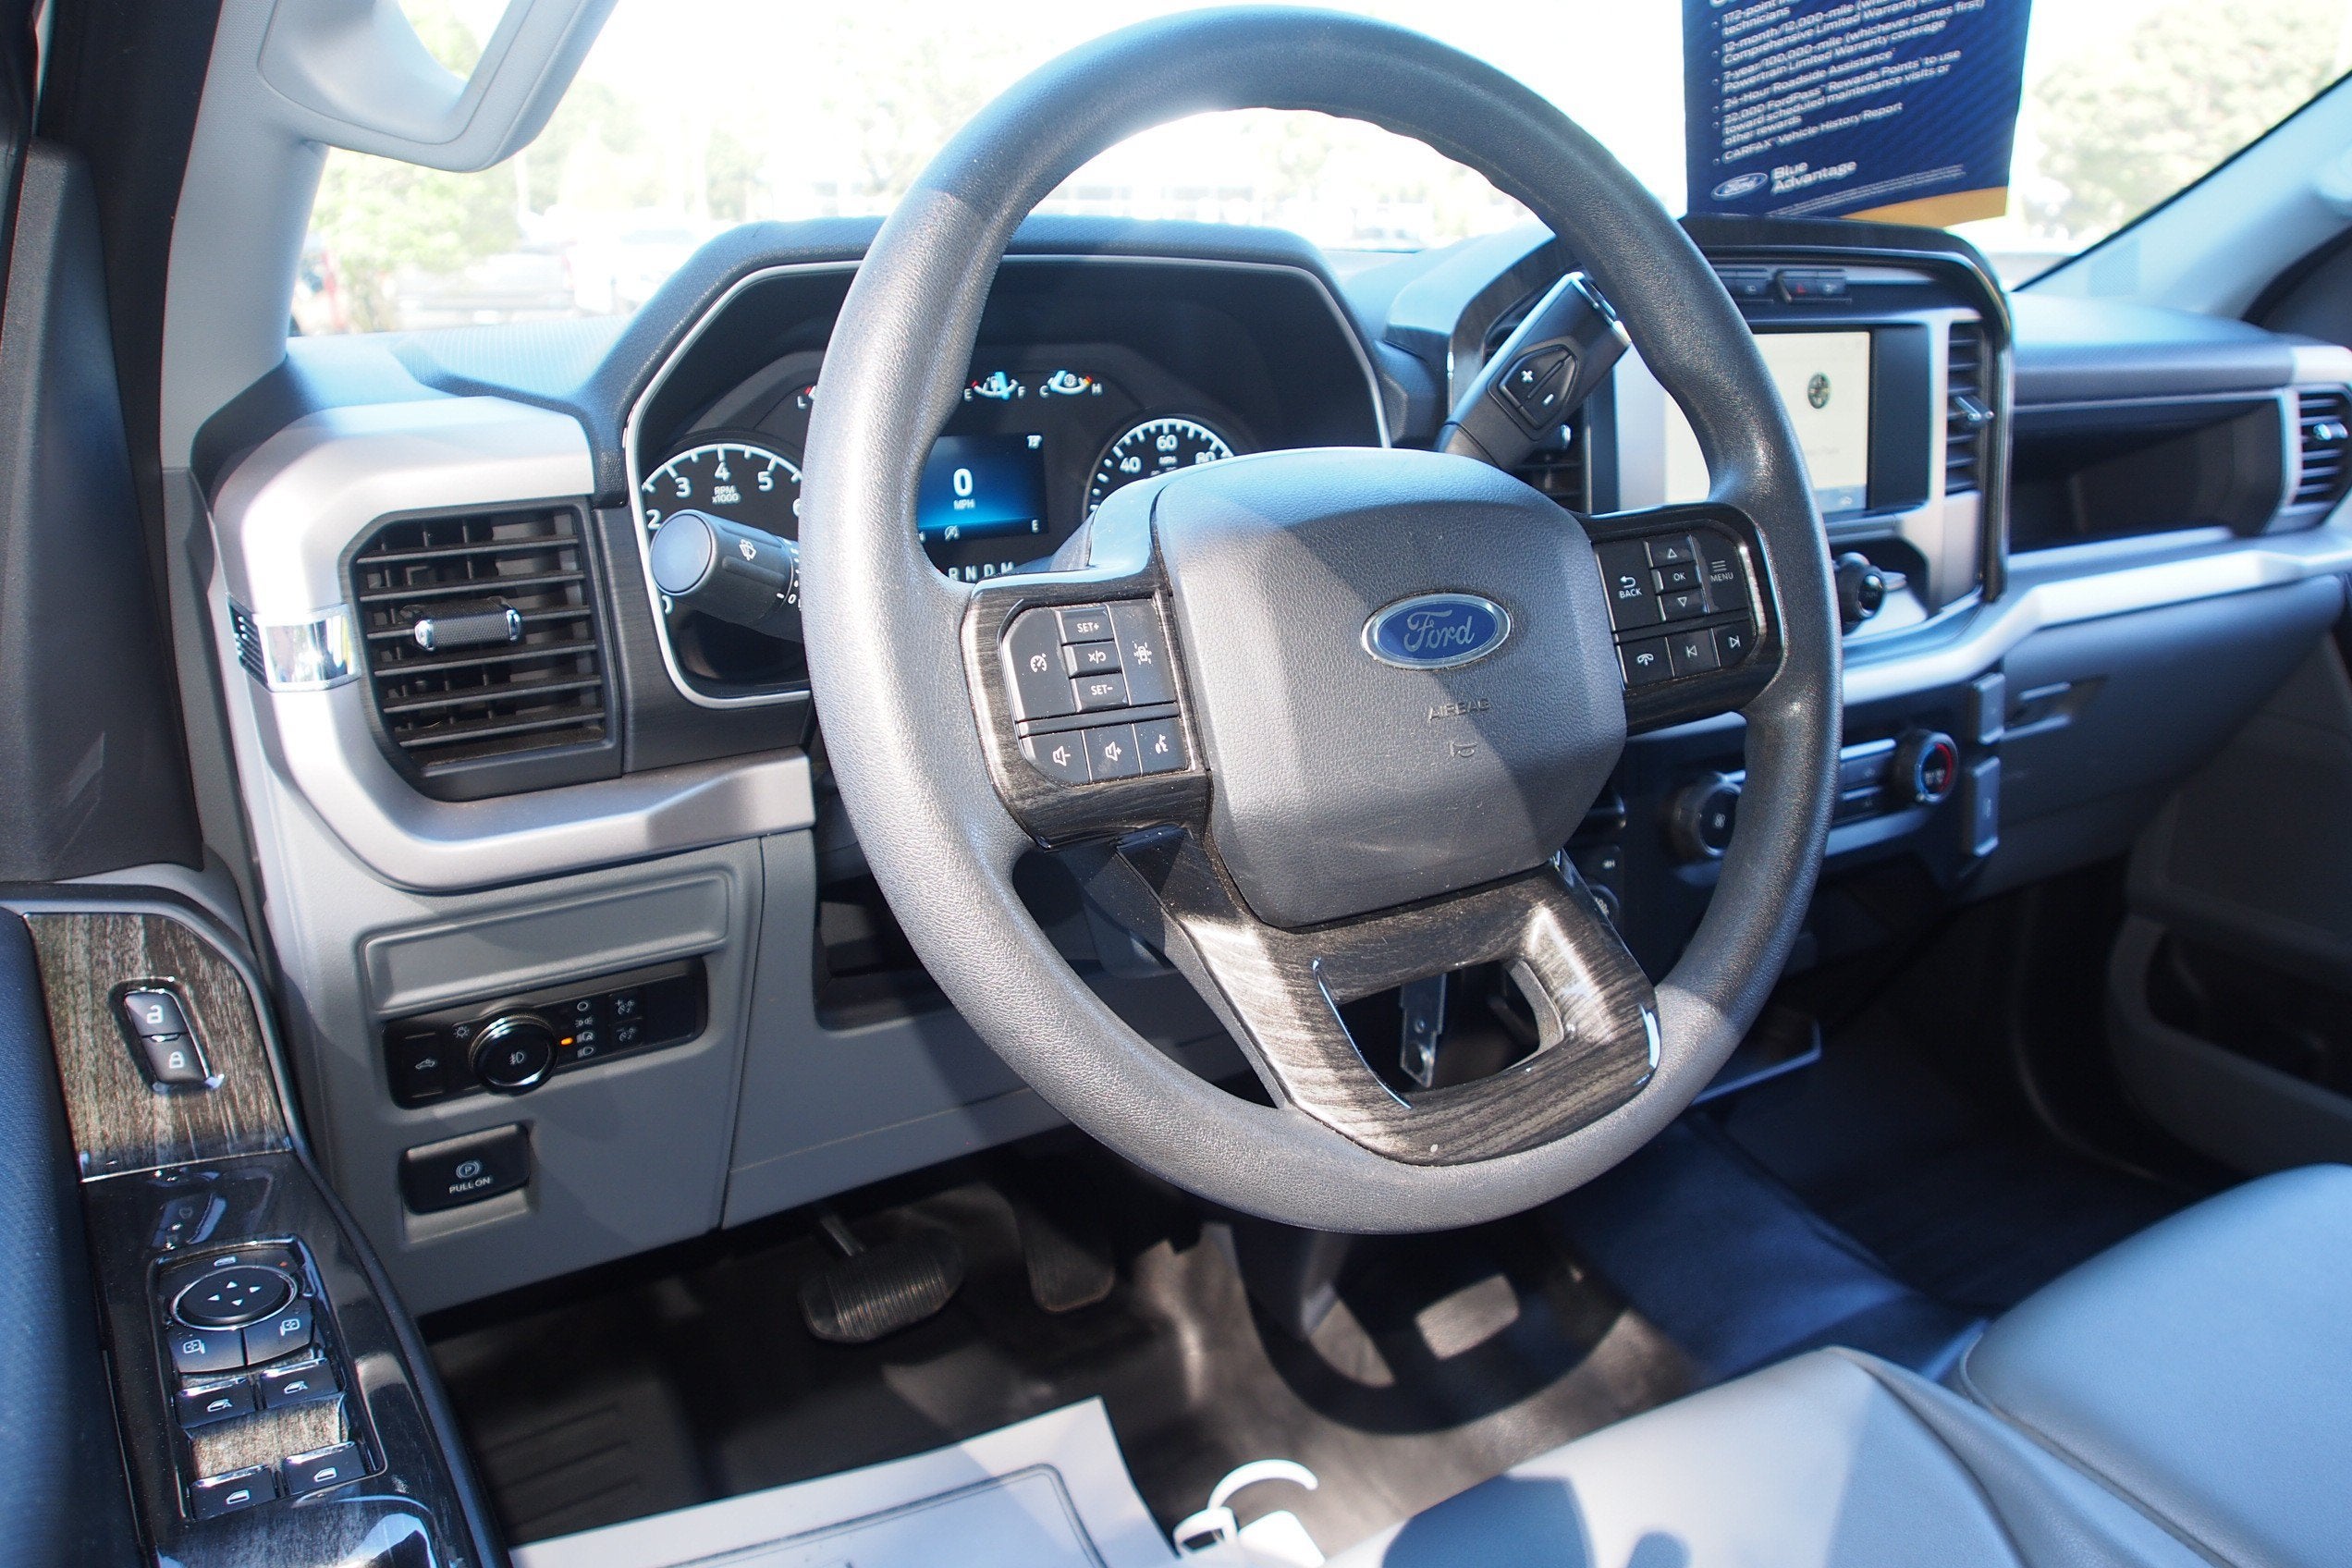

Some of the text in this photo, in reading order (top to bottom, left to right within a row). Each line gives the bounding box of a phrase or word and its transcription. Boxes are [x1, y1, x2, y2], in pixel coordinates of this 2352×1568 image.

[1722, 6, 1791, 36] technicians
[1844, 17, 1911, 43] (whichever
[1911, 6, 1954, 23] comes
[1722, 29, 1814, 64] Comprehensive
[1816, 13, 1861, 33] Limited
[1862, 0, 1918, 19] Warranty
[1722, 66, 1787, 93] Powertrain
[1788, 49, 1833, 71] Limited
[1834, 34, 1889, 56] Warranty
[1827, 70, 1880, 92] Rewards
[1923, 55, 1938, 66] to
[1939, 49, 1962, 62] use
[1722, 87, 1771, 109] 24-Hour
[1772, 68, 1828, 92] Roadside
[1722, 63, 1951, 136] toward scheduled maintenance visits or
[1723, 114, 1803, 146] other rewards
[1776, 125, 1819, 143] Vehicle
[1820, 113, 1862, 131] History
[1863, 101, 1903, 120] Report
[1773, 162, 1808, 180] Blue
[1773, 161, 1857, 191] Advantage
[964, 388, 972, 401] E
[1018, 386, 1027, 398] F
[1040, 386, 1049, 398] C
[1092, 383, 1103, 395] H
[797, 396, 807, 409] L
[1156, 435, 1178, 451] 60
[715, 462, 730, 482] 4
[1120, 457, 1142, 473] 40
[675, 477, 692, 497] 3
[714, 485, 737, 495] RPM
[757, 472, 774, 491] 5
[953, 468, 974, 497] 0
[712, 493, 741, 504] x1000
[953, 499, 975, 510] MPH
[646, 510, 661, 530] 2
[965, 565, 978, 582] N
[984, 563, 996, 578] D
[1672, 571, 1686, 582] OK
[1710, 571, 1734, 582] MENU
[1619, 587, 1643, 599] BACK
[1076, 622, 1100, 633] SET+
[1403, 609, 1476, 652] Ford
[1427, 698, 1490, 722] AIRBAG
[448, 1177, 491, 1194] PULL ON
